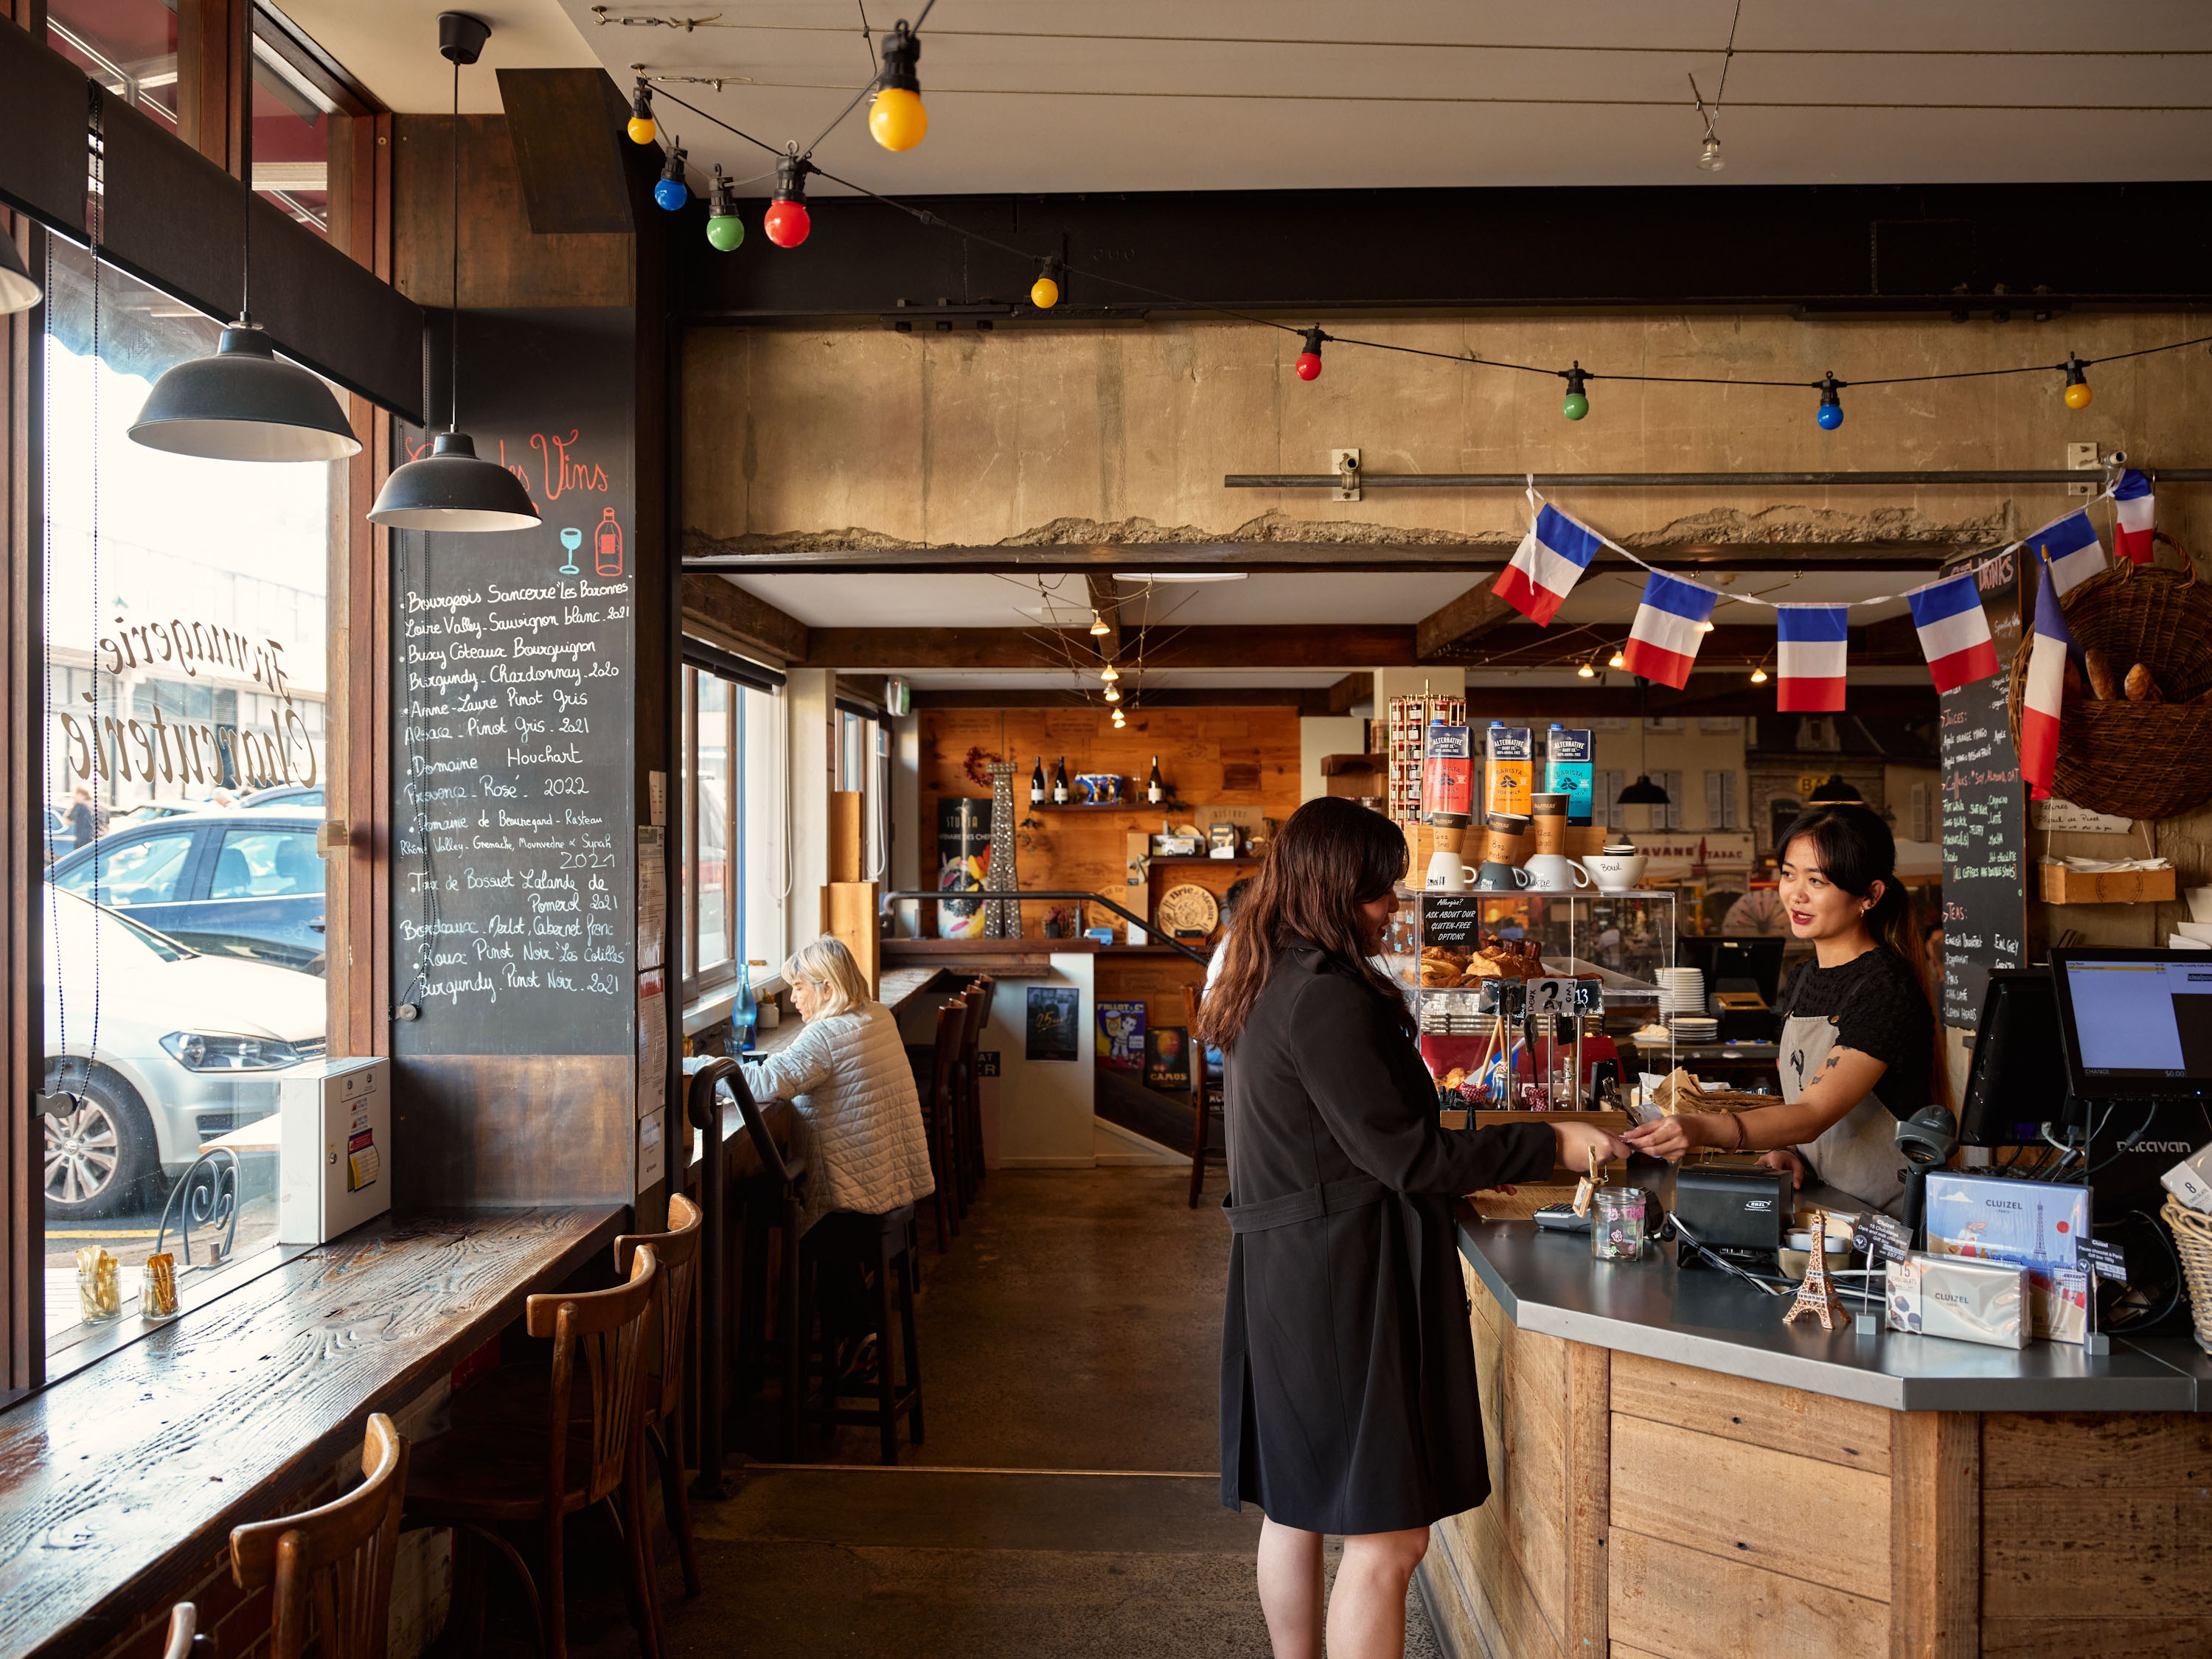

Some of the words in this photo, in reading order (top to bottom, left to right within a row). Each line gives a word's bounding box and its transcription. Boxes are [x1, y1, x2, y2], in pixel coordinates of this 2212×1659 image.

[530, 428, 609, 500] Vins
[1978, 555, 2014, 591] DRINKS
[407, 588, 481, 613] Bourgeois
[487, 585, 555, 603] Sancerre
[406, 621, 439, 638] Loire
[489, 612, 559, 634] Sauvignon
[564, 605, 600, 625] blanc
[607, 606, 629, 619] 2021
[513, 637, 596, 661] Bourguignon
[408, 671, 479, 695] Burgundy
[490, 664, 581, 686] Chardonnay
[588, 661, 619, 678] 2020
[507, 686, 543, 708] Pinot
[553, 689, 588, 713] Gris
[404, 726, 453, 745] Alsace
[467, 717, 508, 736] Pinot
[515, 719, 546, 744] Gris
[559, 717, 590, 734] 2021
[1433, 737, 1463, 745] ALTERNATIVE
[1494, 739, 1524, 747] ALTERNATIVE
[1554, 741, 1585, 749] ALTERNATIVE
[414, 755, 478, 774] Domaine
[507, 743, 583, 767] Houchart
[544, 776, 589, 796] 2022
[478, 810, 490, 827] de
[433, 836, 464, 858] Valley
[560, 852, 615, 869] 2021
[1707, 850, 1743, 859] TABAC
[445, 874, 459, 891] de
[519, 869, 578, 891] Lalande
[588, 877, 609, 891] de
[1169, 886, 1193, 900] Brie
[527, 894, 582, 913] Pomerol
[589, 894, 618, 910] 2021
[1437, 898, 1464, 907] Allergies?
[1439, 911, 1461, 919] ABOUT
[533, 917, 583, 937] Cabernet
[1431, 922, 1472, 931] GLUTEN-FREE
[472, 939, 514, 961] Pinot
[524, 943, 554, 961] Noir
[419, 973, 496, 1005] Burgundy
[502, 961, 540, 989] Pinot
[547, 971, 577, 992] Noir
[586, 973, 619, 995] 2021
[1576, 989, 1588, 1004] 13
[1150, 1073, 1187, 1081] CAMUS
[2185, 1182, 2197, 1193] 8
[1986, 1200, 2023, 1210] CLUIZEL
[1876, 1225, 1899, 1237] Chocolates
[1877, 1220, 1895, 1230] Cluizel
[2092, 1239, 2109, 1248] Cluizel
[1887, 1251, 1904, 1261] $57.00
[2092, 1248, 2108, 1256] chocolat
[1899, 1265, 1910, 1277] 15
[1891, 1276, 1917, 1285] CHOCOLATS
[1935, 1293, 1969, 1304] CLUIZEL
